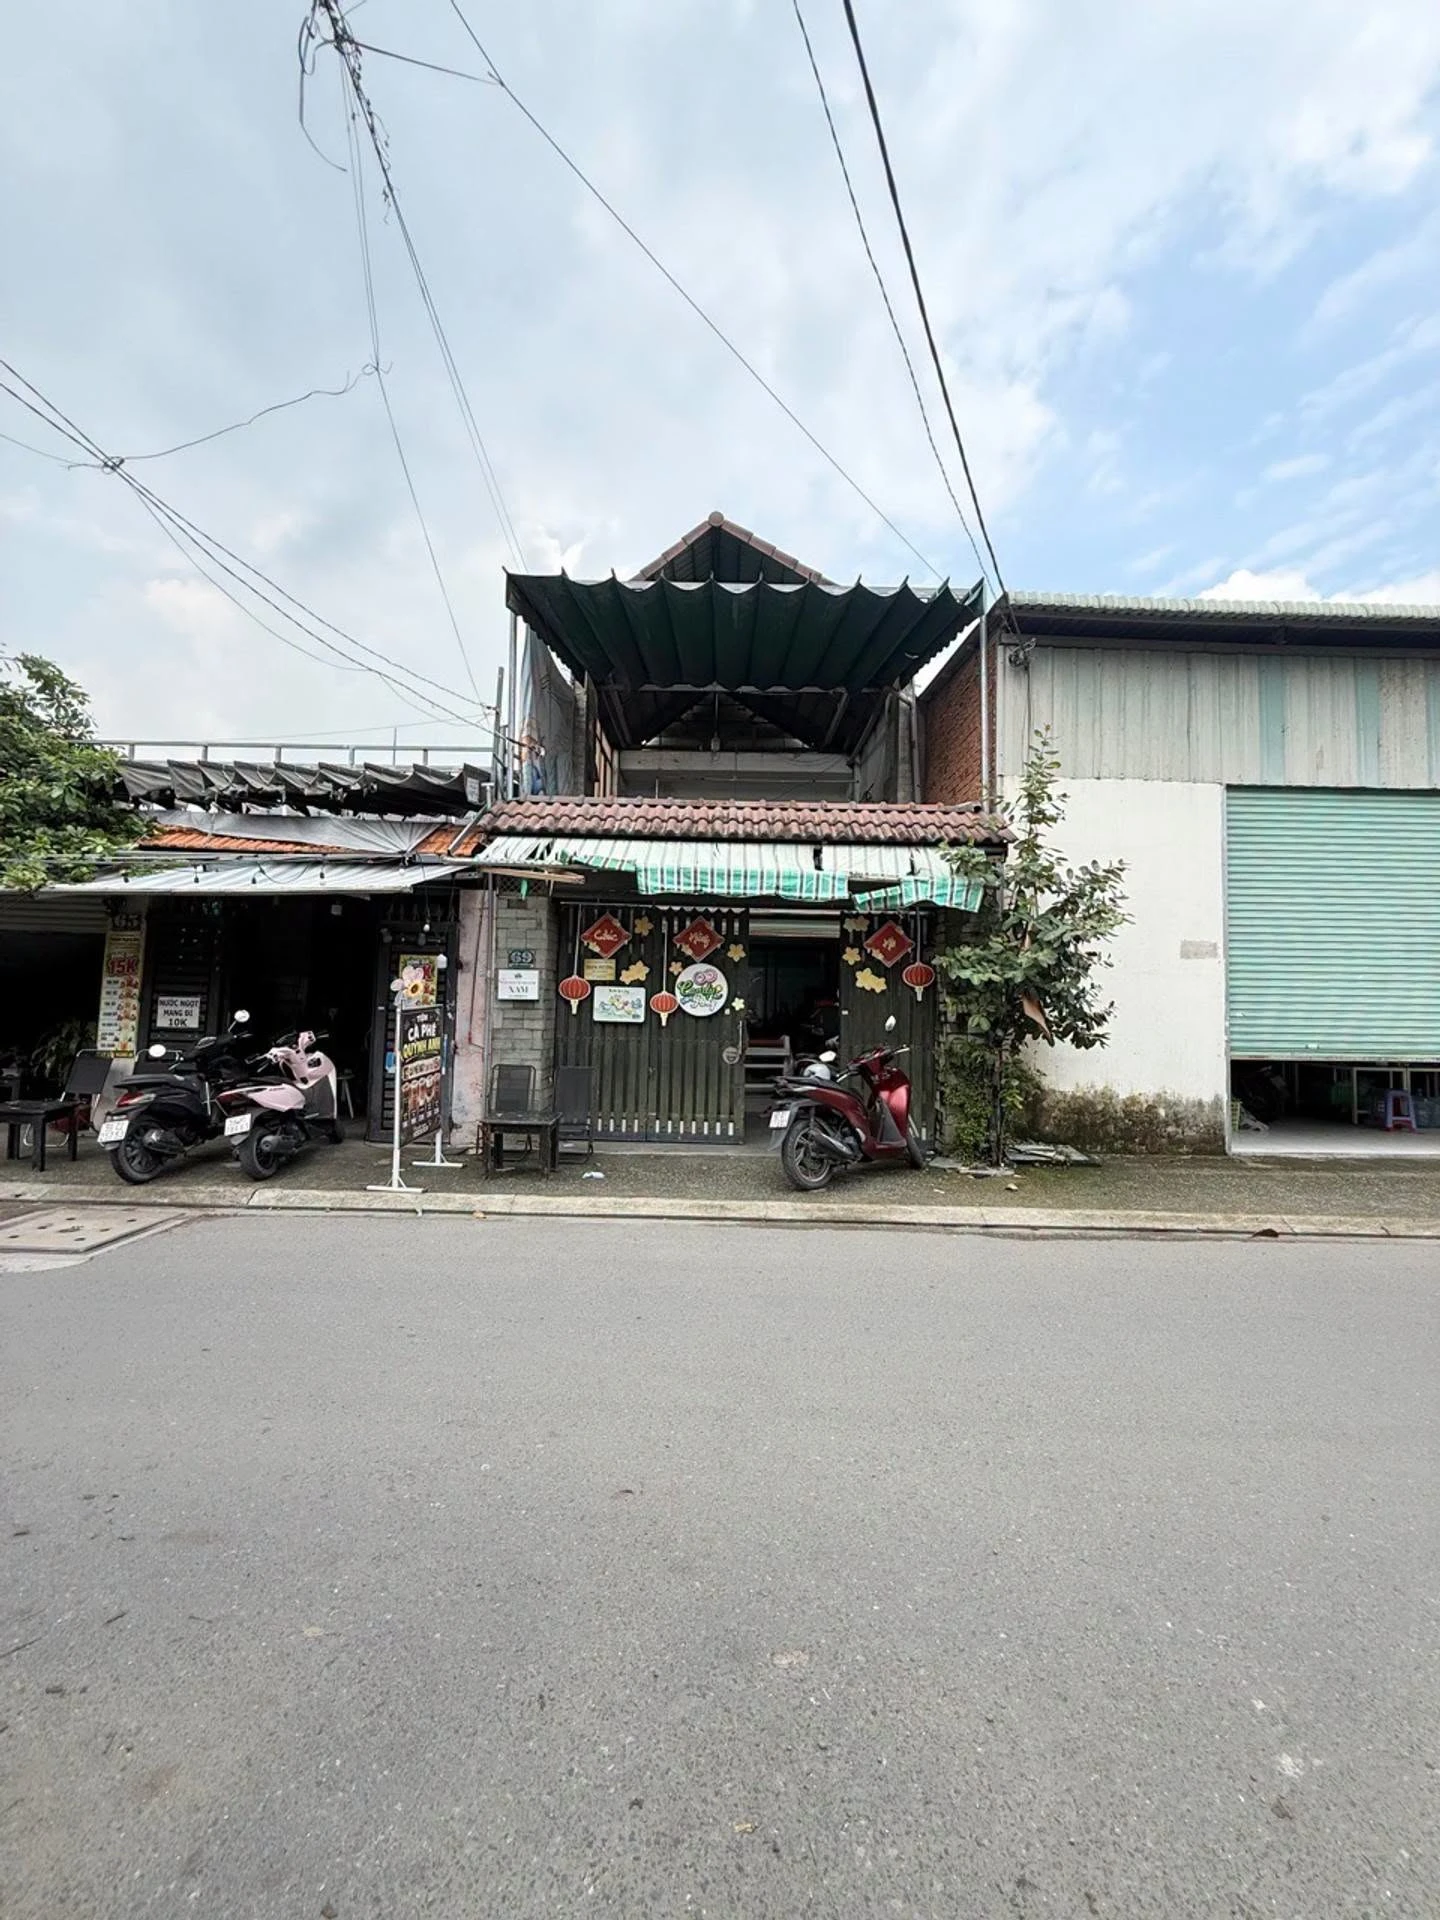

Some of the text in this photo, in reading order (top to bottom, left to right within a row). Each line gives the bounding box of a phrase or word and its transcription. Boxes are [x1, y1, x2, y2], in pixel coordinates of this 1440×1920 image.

[511, 951, 532, 963] 69
[109, 958, 136, 976] 15K
[163, 1009, 183, 1017] MANG
[168, 1018, 188, 1027] 10K
